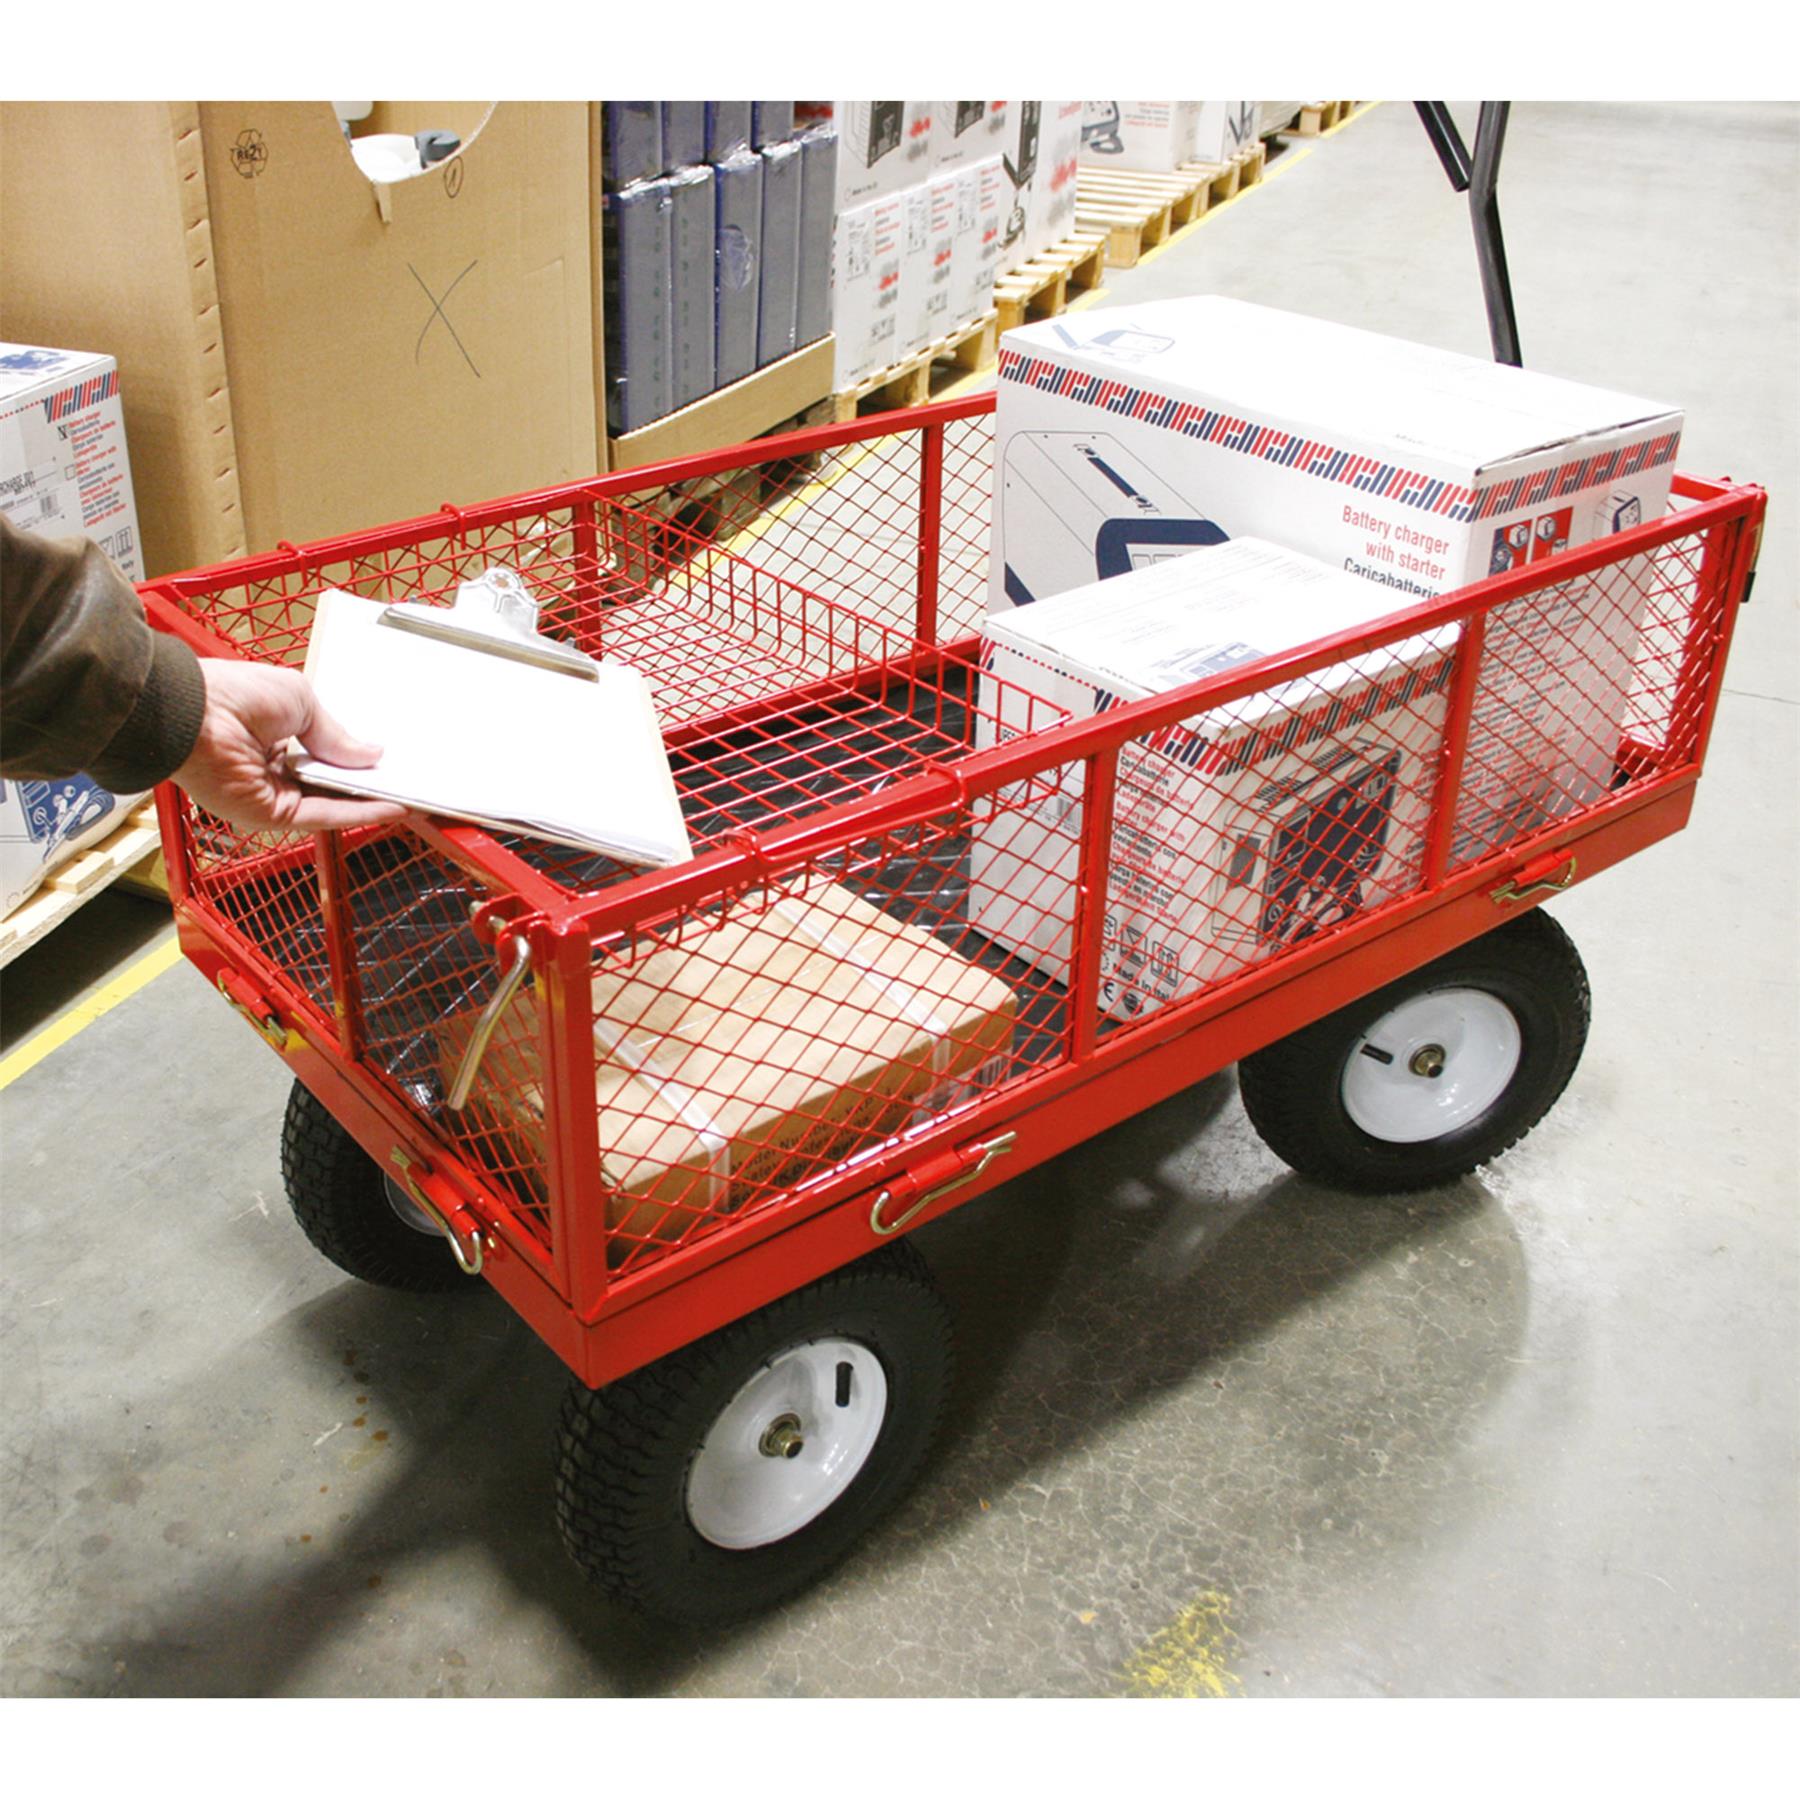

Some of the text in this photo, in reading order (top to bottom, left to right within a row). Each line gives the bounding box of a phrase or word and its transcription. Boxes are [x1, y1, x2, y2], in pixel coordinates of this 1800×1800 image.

[1343, 505, 1450, 555] Battery charger
[1366, 542, 1446, 580] with starter
